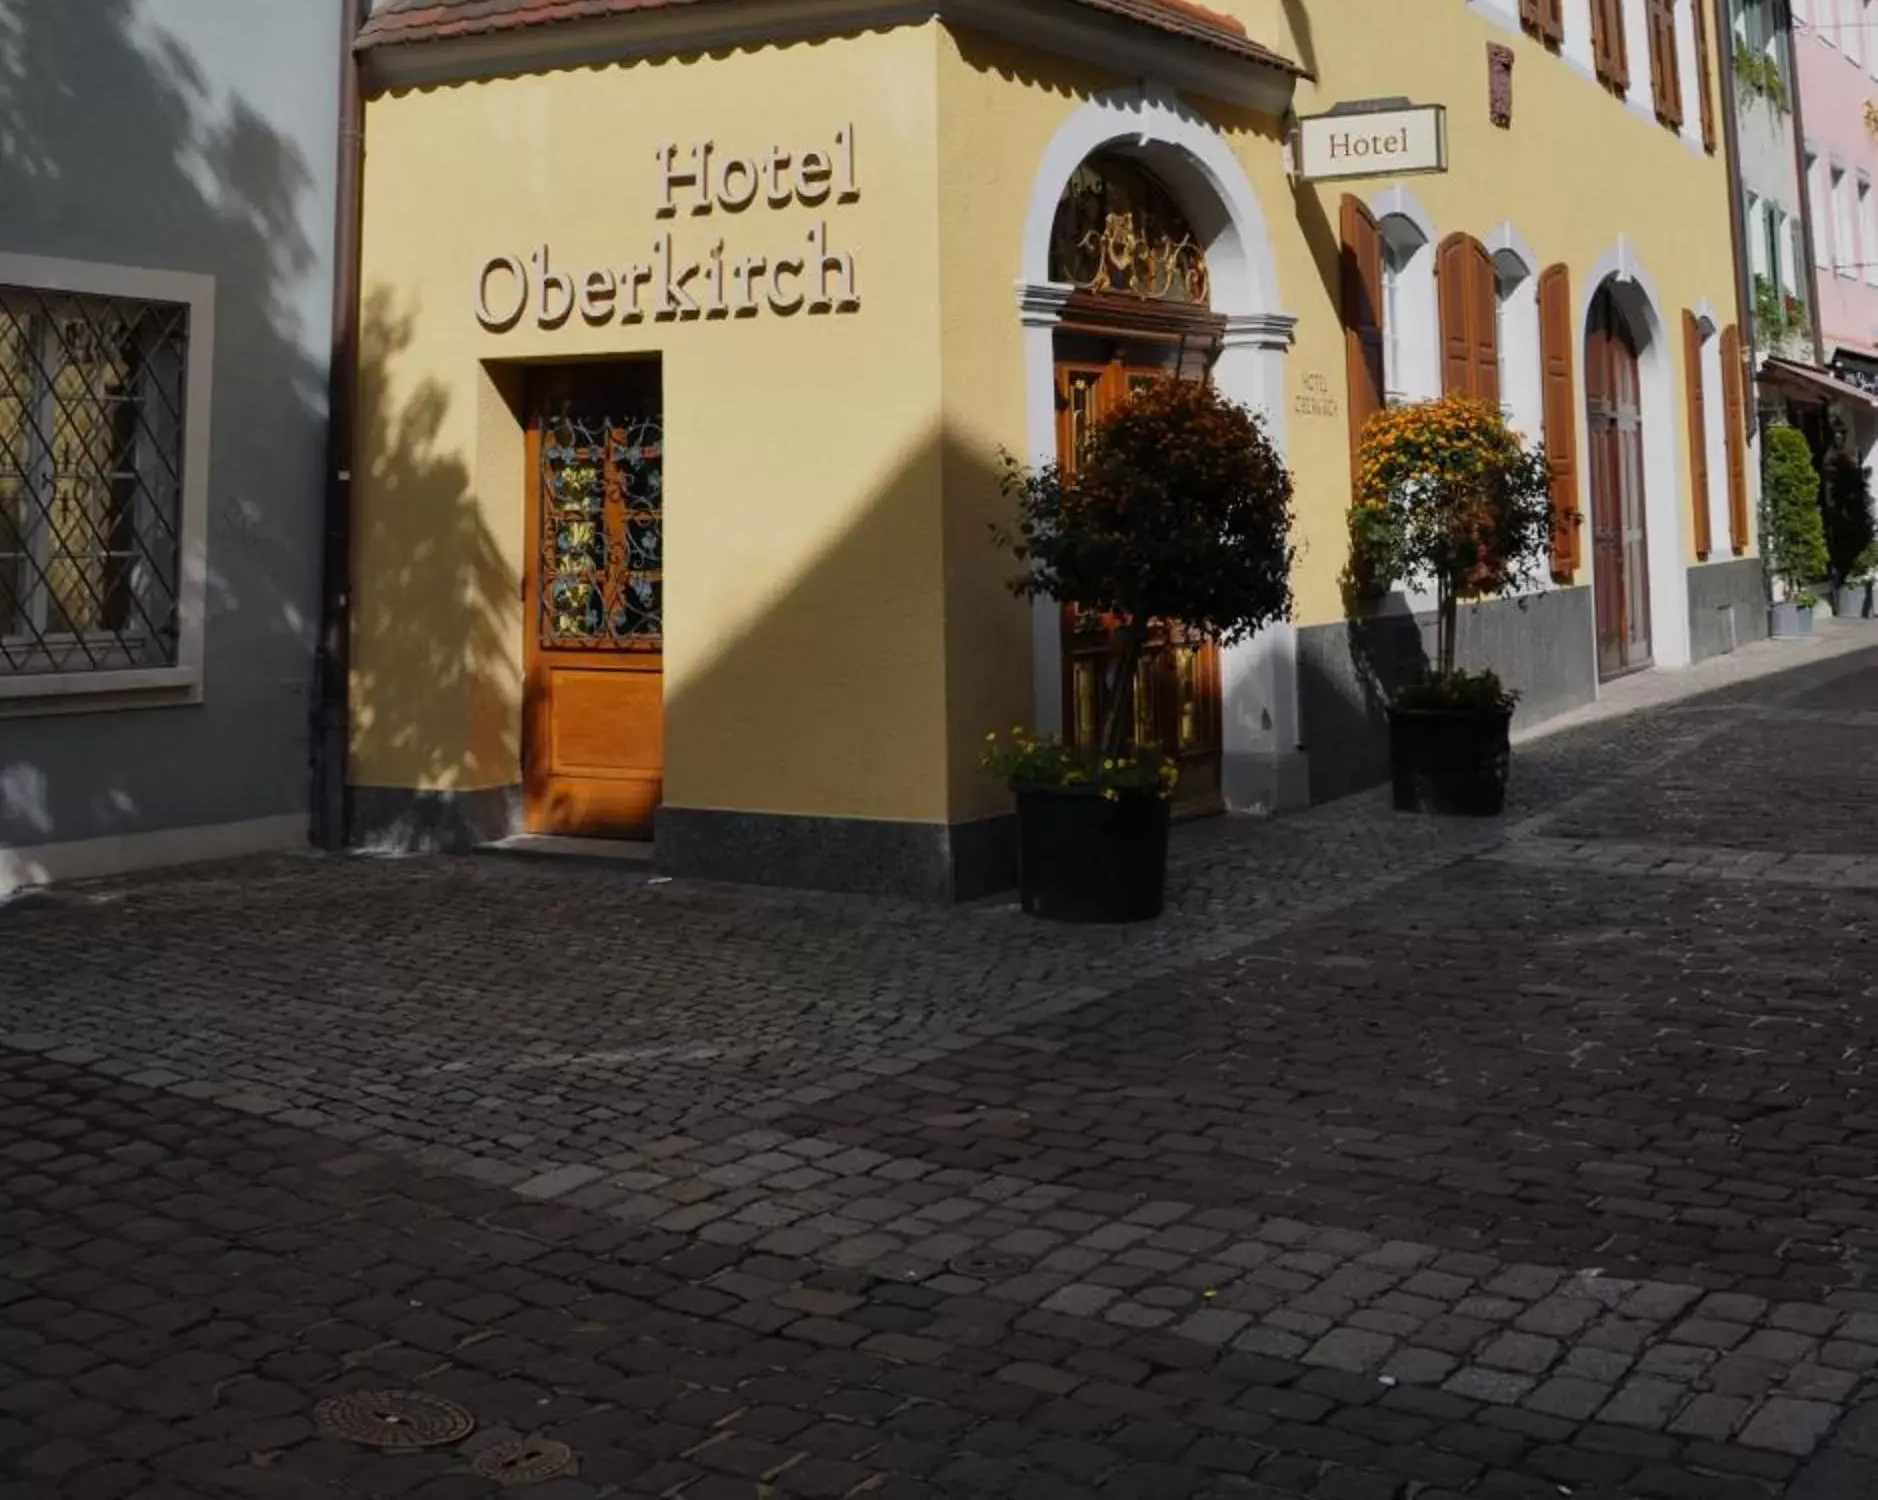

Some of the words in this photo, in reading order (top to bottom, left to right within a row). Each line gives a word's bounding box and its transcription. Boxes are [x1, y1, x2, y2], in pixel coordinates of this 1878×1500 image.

[655, 122, 861, 219] Hotel
[1329, 127, 1408, 159] Hotel
[473, 221, 861, 334] Oberkirch
